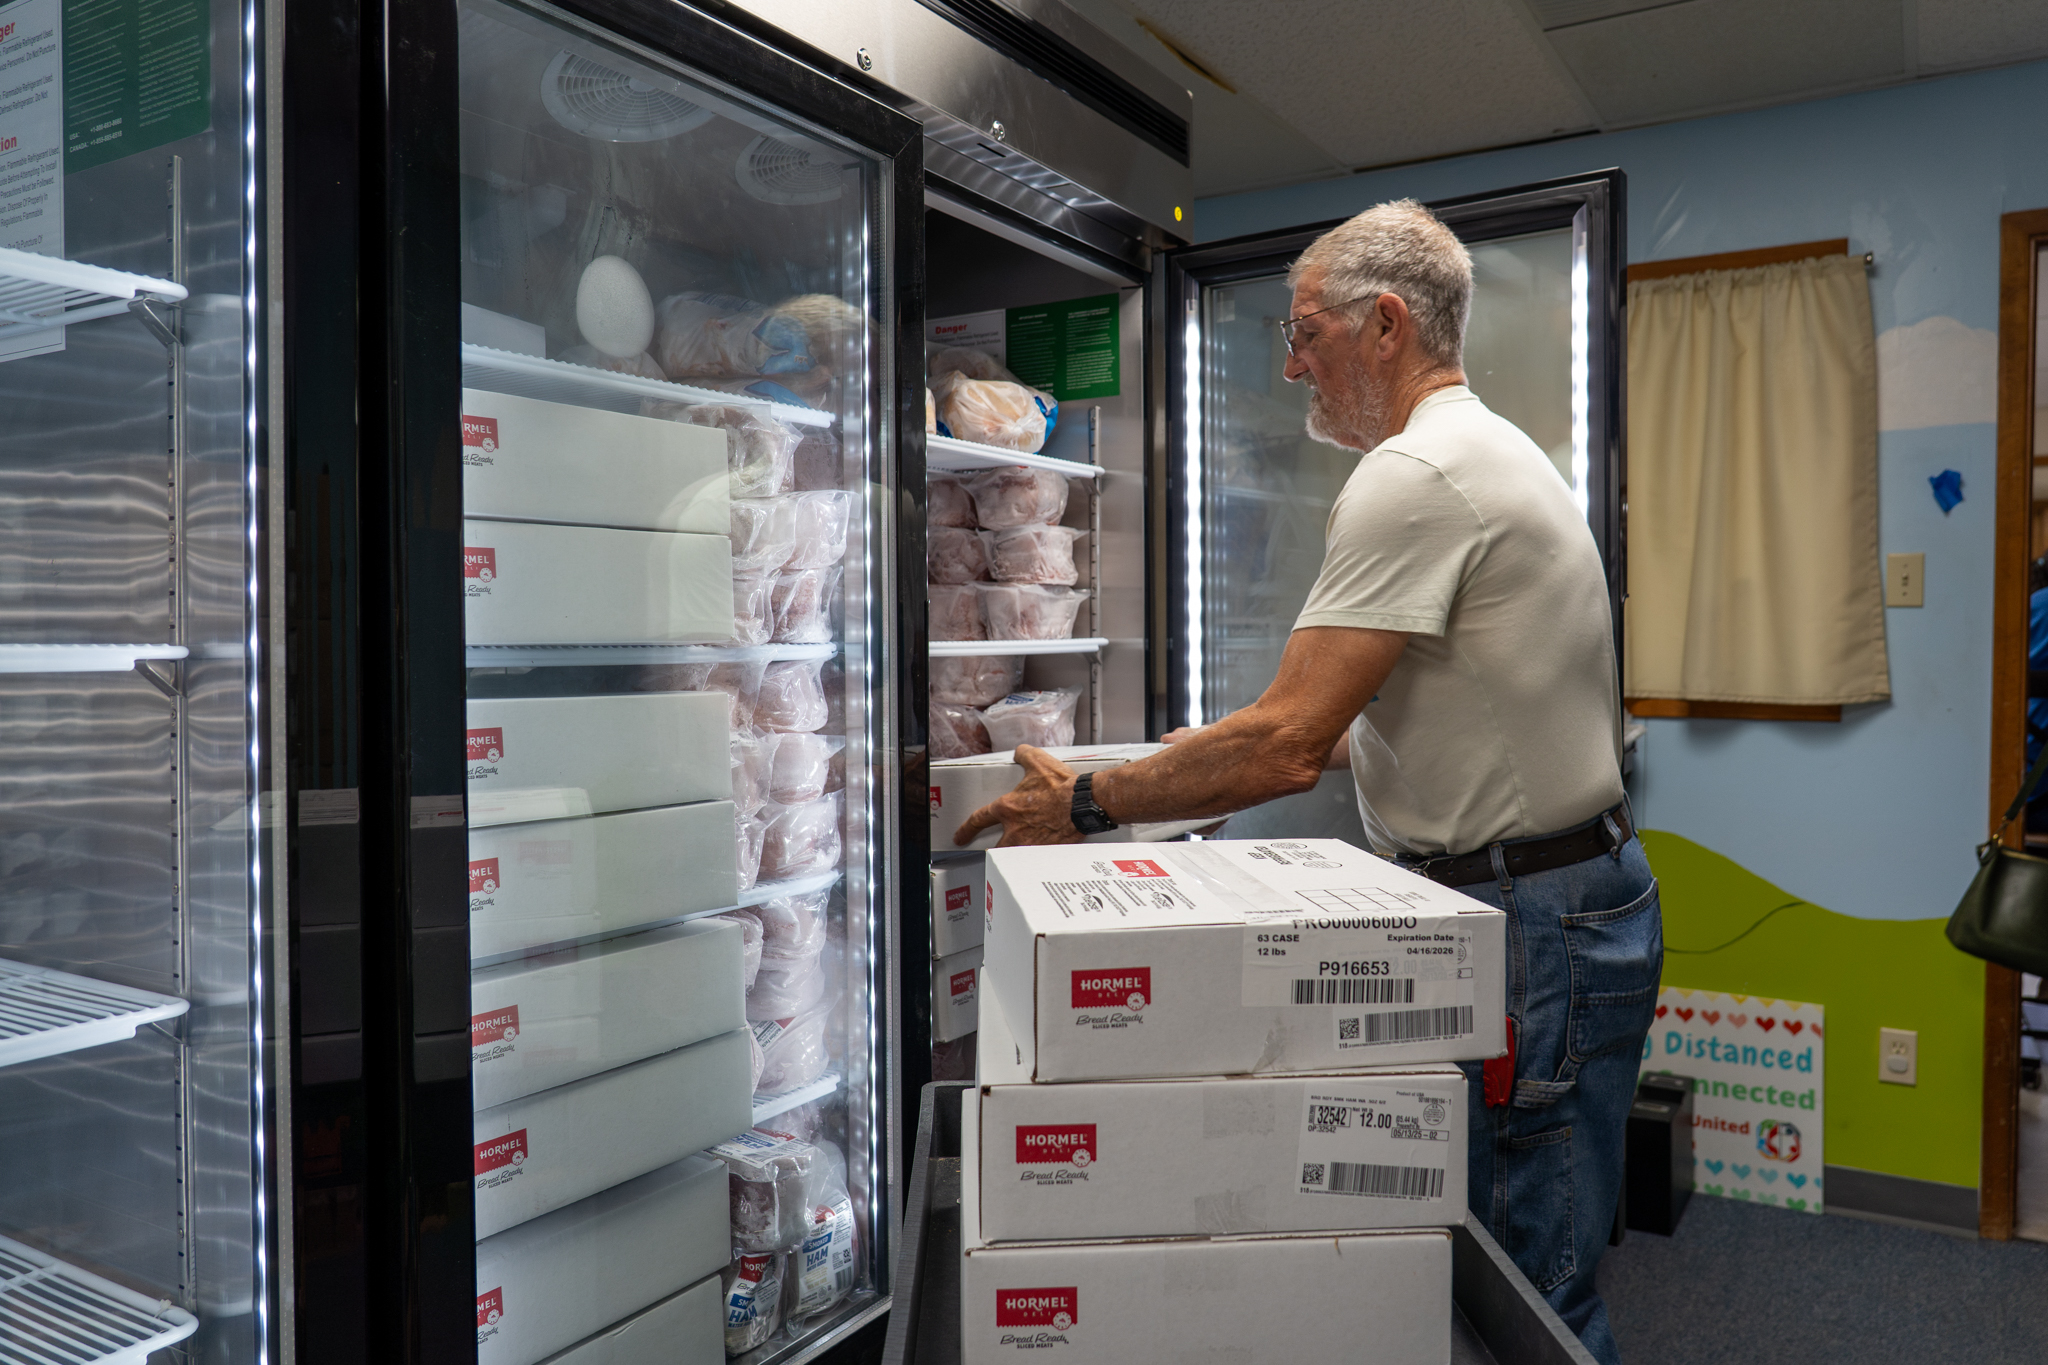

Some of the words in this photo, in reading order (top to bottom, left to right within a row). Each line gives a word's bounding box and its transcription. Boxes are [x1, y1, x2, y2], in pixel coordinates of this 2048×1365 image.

[935, 323, 968, 335] Danger
[464, 423, 492, 435] RMEL
[470, 453, 494, 465] Ready
[465, 555, 490, 566] RMEL
[467, 584, 492, 595] Ready
[475, 766, 499, 775] Ready
[948, 891, 968, 901] HORMEL
[471, 898, 495, 908] Ready
[1257, 935, 1270, 943] 63
[1272, 934, 1300, 943] CASE
[1387, 934, 1432, 943] Expiration
[1434, 934, 1454, 942] Date
[1257, 948, 1269, 956] 12
[1271, 948, 1286, 956] lbs
[1406, 947, 1454, 956] 04/16/2026
[1319, 961, 1390, 976] P916653
[952, 974, 973, 986] HORMEL
[1080, 977, 1142, 992] HORMEL
[472, 1015, 513, 1032] HORMEL
[1076, 1014, 1108, 1025] Bread
[1110, 1013, 1143, 1024] Ready
[491, 1044, 515, 1055] Ready
[1665, 1031, 1813, 1073] Distanced
[1693, 1078, 1815, 1111] nnected
[1317, 1106, 1347, 1125] 32542
[1360, 1112, 1391, 1128] 12.00
[1394, 1129, 1422, 1138] 05/13/25
[1429, 1131, 1438, 1139] 02
[1025, 1133, 1088, 1148] HORMEL
[479, 1138, 522, 1160] HORMEL
[477, 1175, 499, 1189] Bread
[500, 1168, 524, 1180] Ready
[1020, 1170, 1053, 1182] Bread
[1055, 1169, 1089, 1181] Ready
[808, 1235, 829, 1250] SMOKED
[806, 1246, 829, 1267] HAM
[744, 1262, 767, 1272] HORM
[1005, 1296, 1068, 1312] HORMEL
[728, 1304, 758, 1323] HAM
[1000, 1334, 1033, 1345] Bread
[1035, 1333, 1069, 1344] Ready
